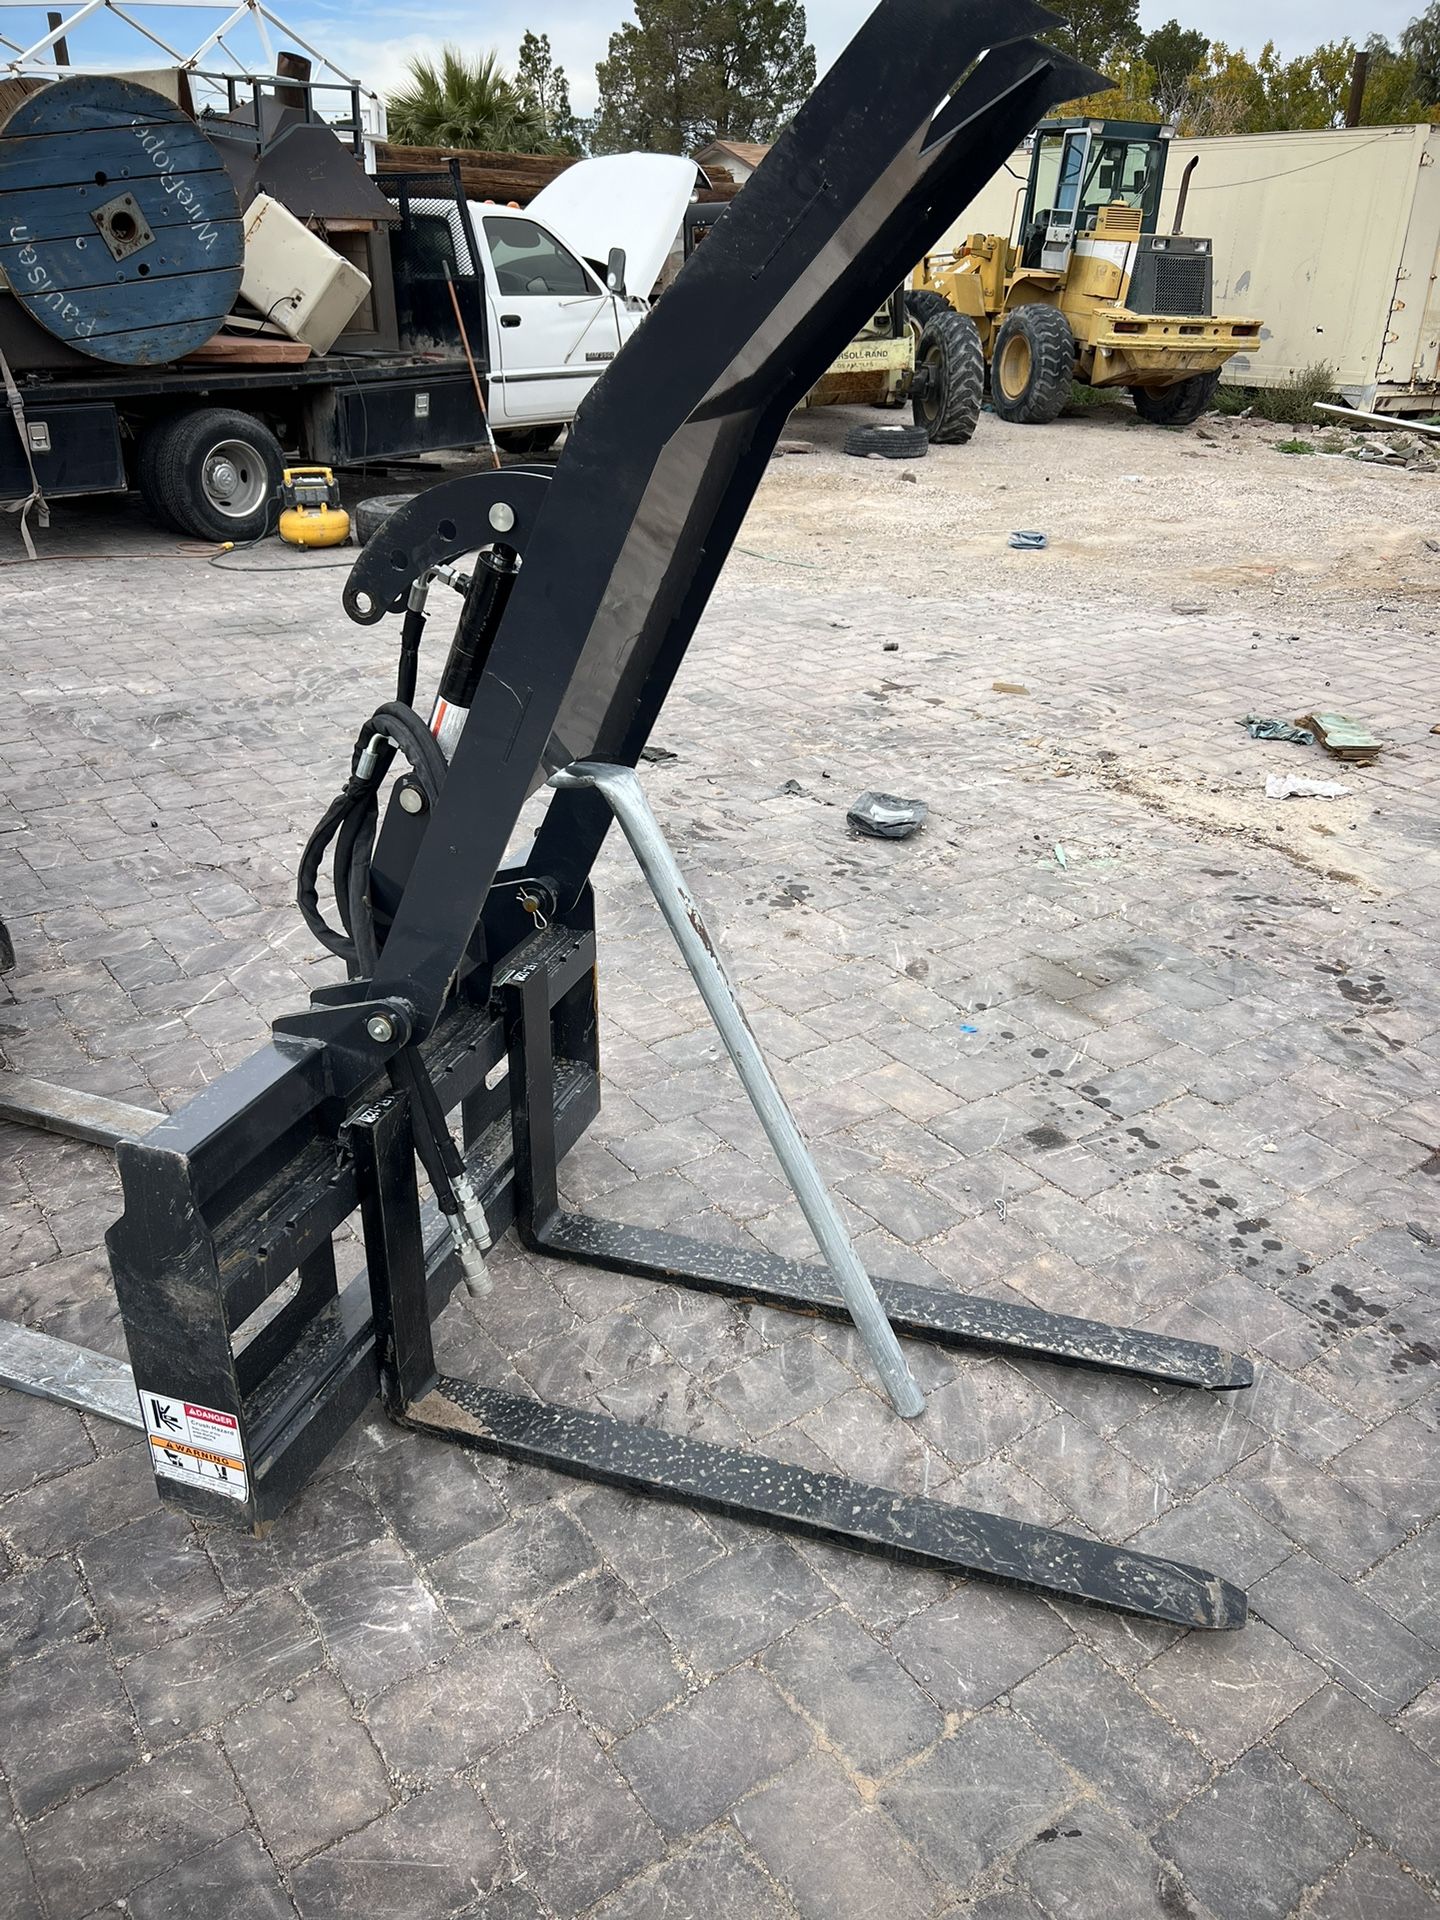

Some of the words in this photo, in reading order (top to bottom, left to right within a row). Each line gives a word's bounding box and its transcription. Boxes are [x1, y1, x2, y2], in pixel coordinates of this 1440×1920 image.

[9, 225, 97, 342] Paulsen
[196, 1410, 232, 1425] DANGER
[190, 1419, 211, 1430] Crush
[211, 1425, 235, 1436] Hazard
[174, 1444, 230, 1465] WARNING
